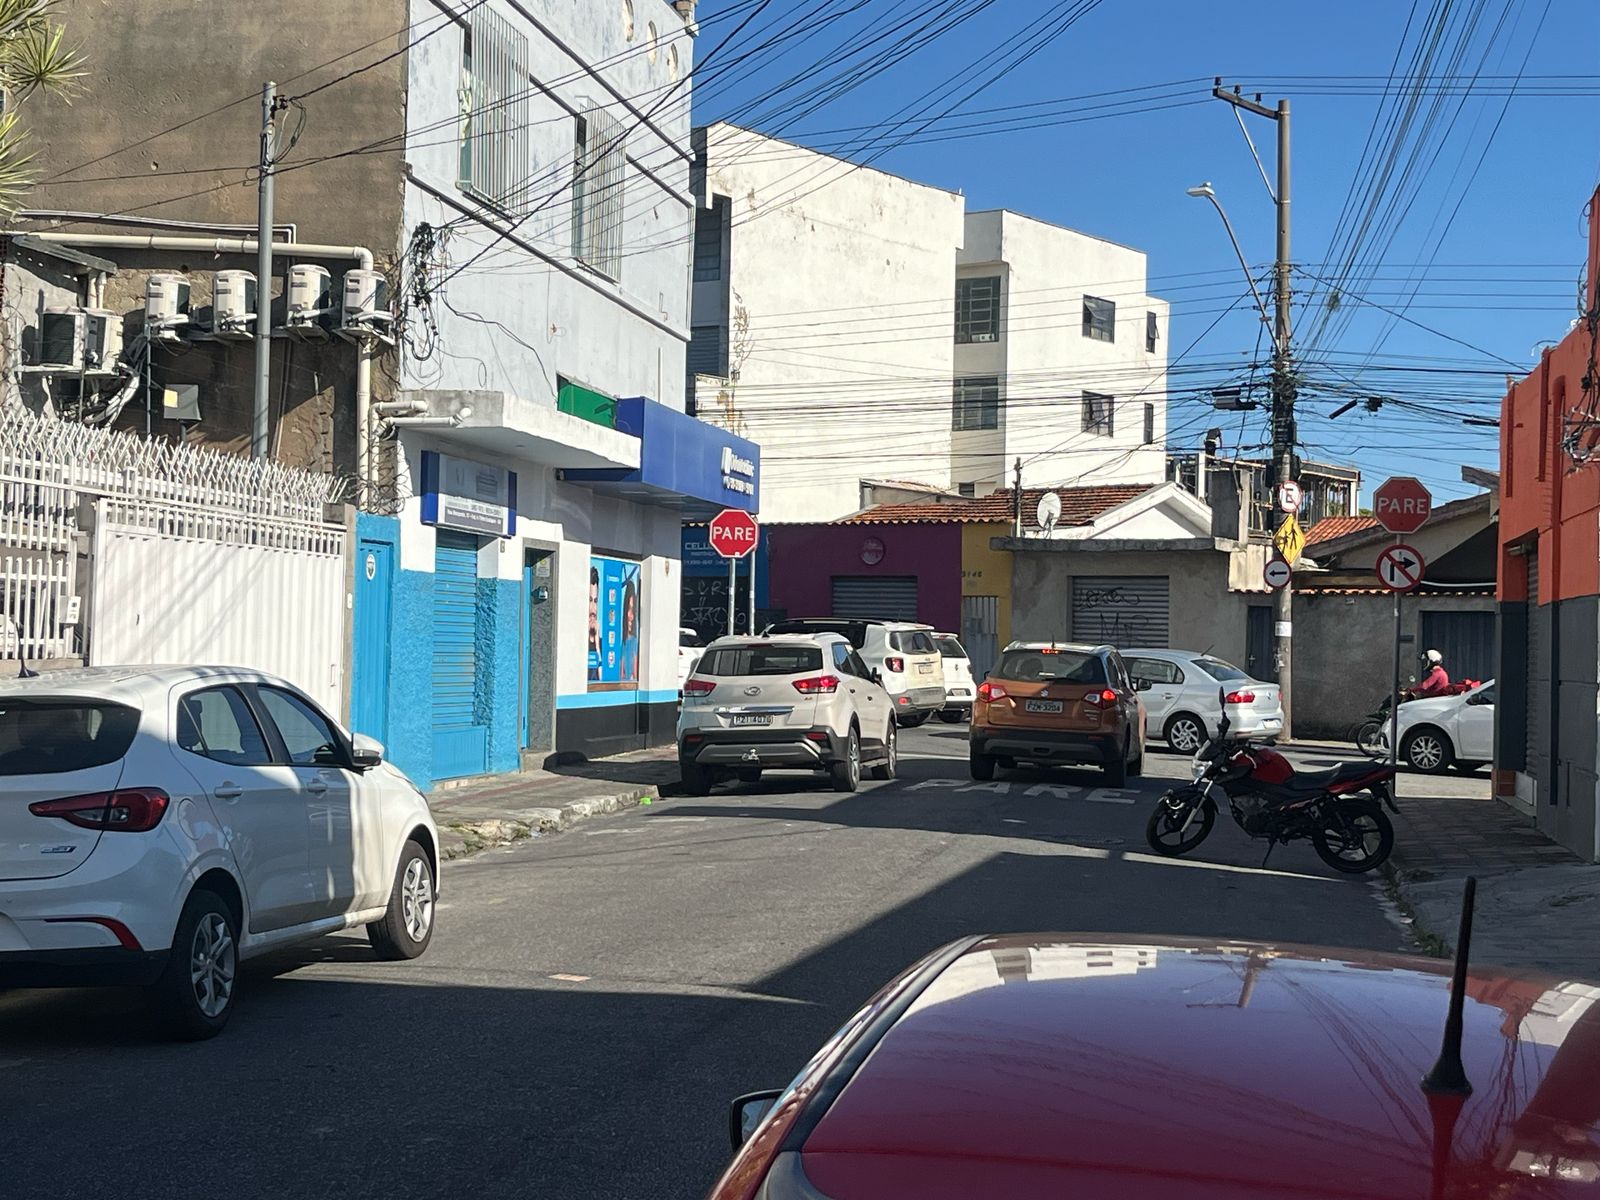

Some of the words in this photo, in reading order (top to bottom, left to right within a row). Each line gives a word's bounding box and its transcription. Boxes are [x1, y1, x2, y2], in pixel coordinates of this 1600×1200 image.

[1377, 497, 1427, 514] PARE
[713, 526, 754, 541] PARE
[903, 779, 1141, 804] PARE
